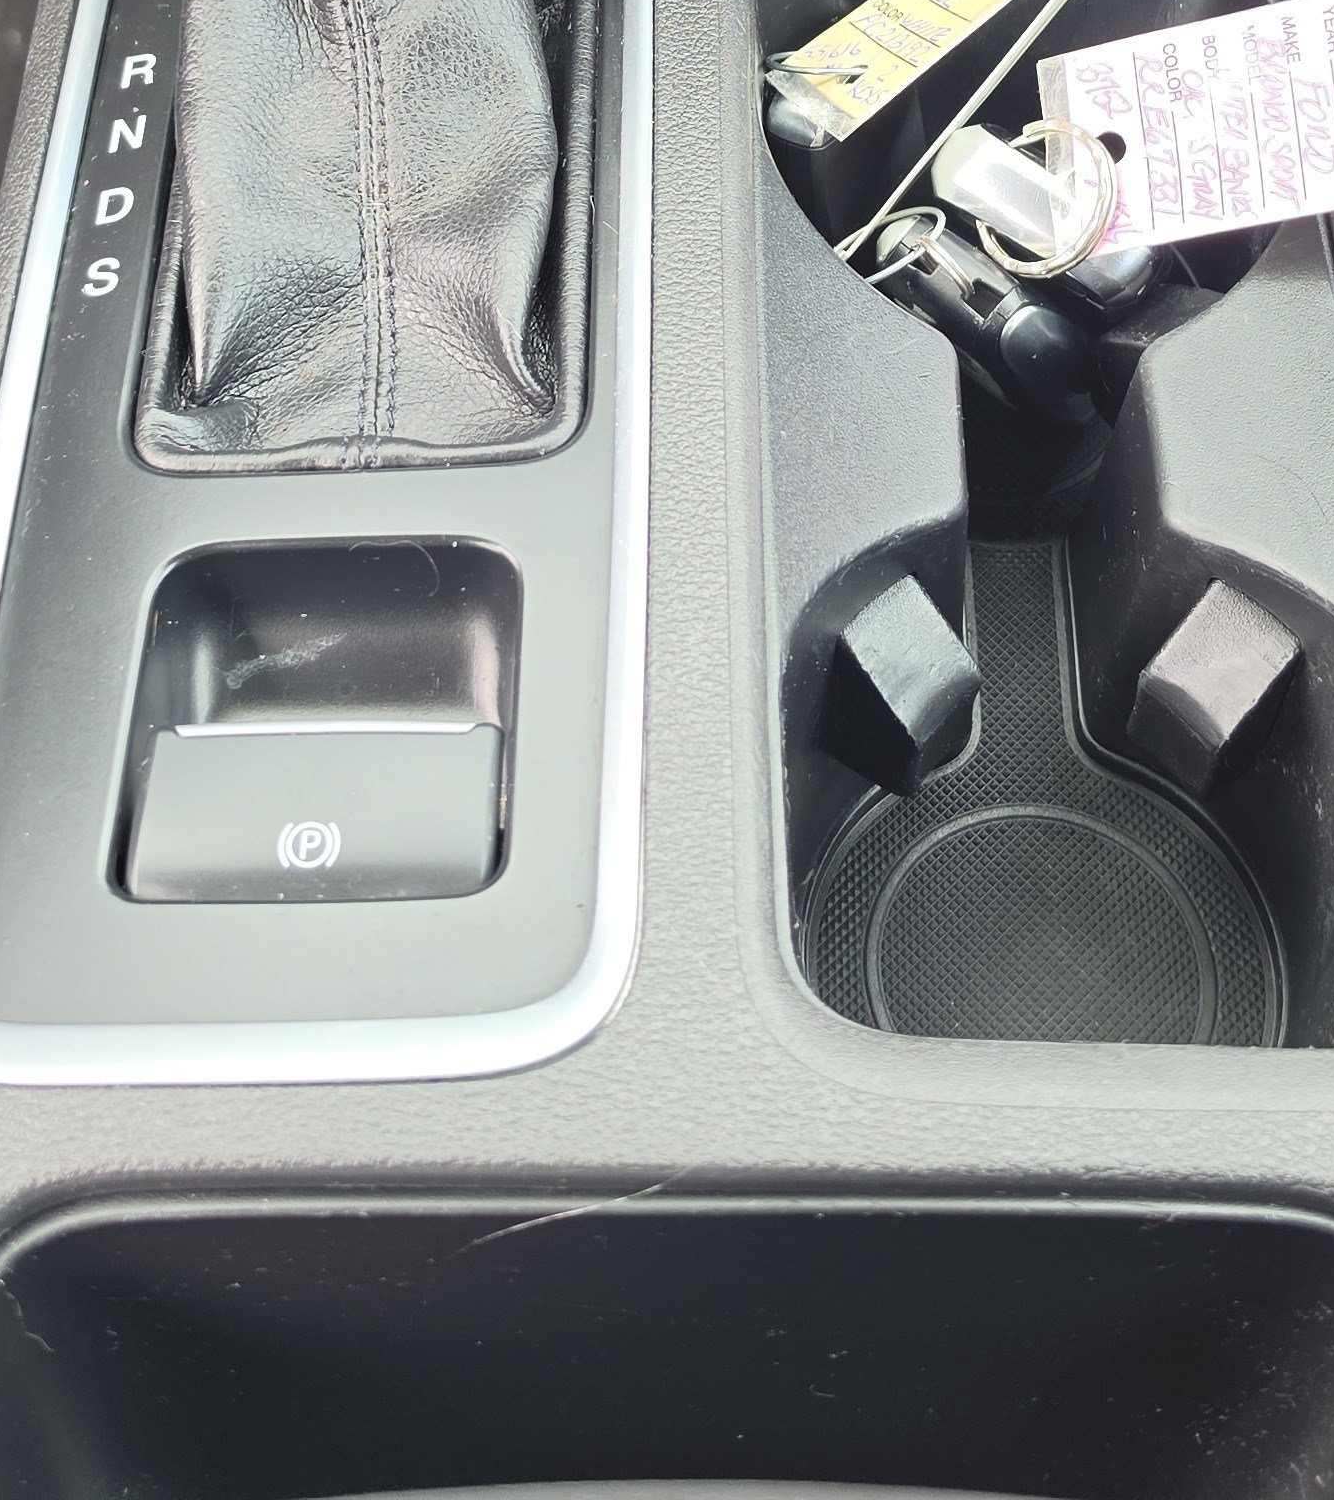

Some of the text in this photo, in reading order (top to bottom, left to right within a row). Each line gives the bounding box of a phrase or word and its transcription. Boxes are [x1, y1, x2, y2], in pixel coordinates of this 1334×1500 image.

[1201, 34, 1220, 80] BODY
[1242, 25, 1262, 85] MODEL
[1281, 16, 1301, 64] MAKE
[119, 53, 157, 89] R
[1163, 43, 1182, 102] COLOR
[107, 114, 147, 153] N
[94, 187, 135, 225] D
[81, 257, 121, 297] S
